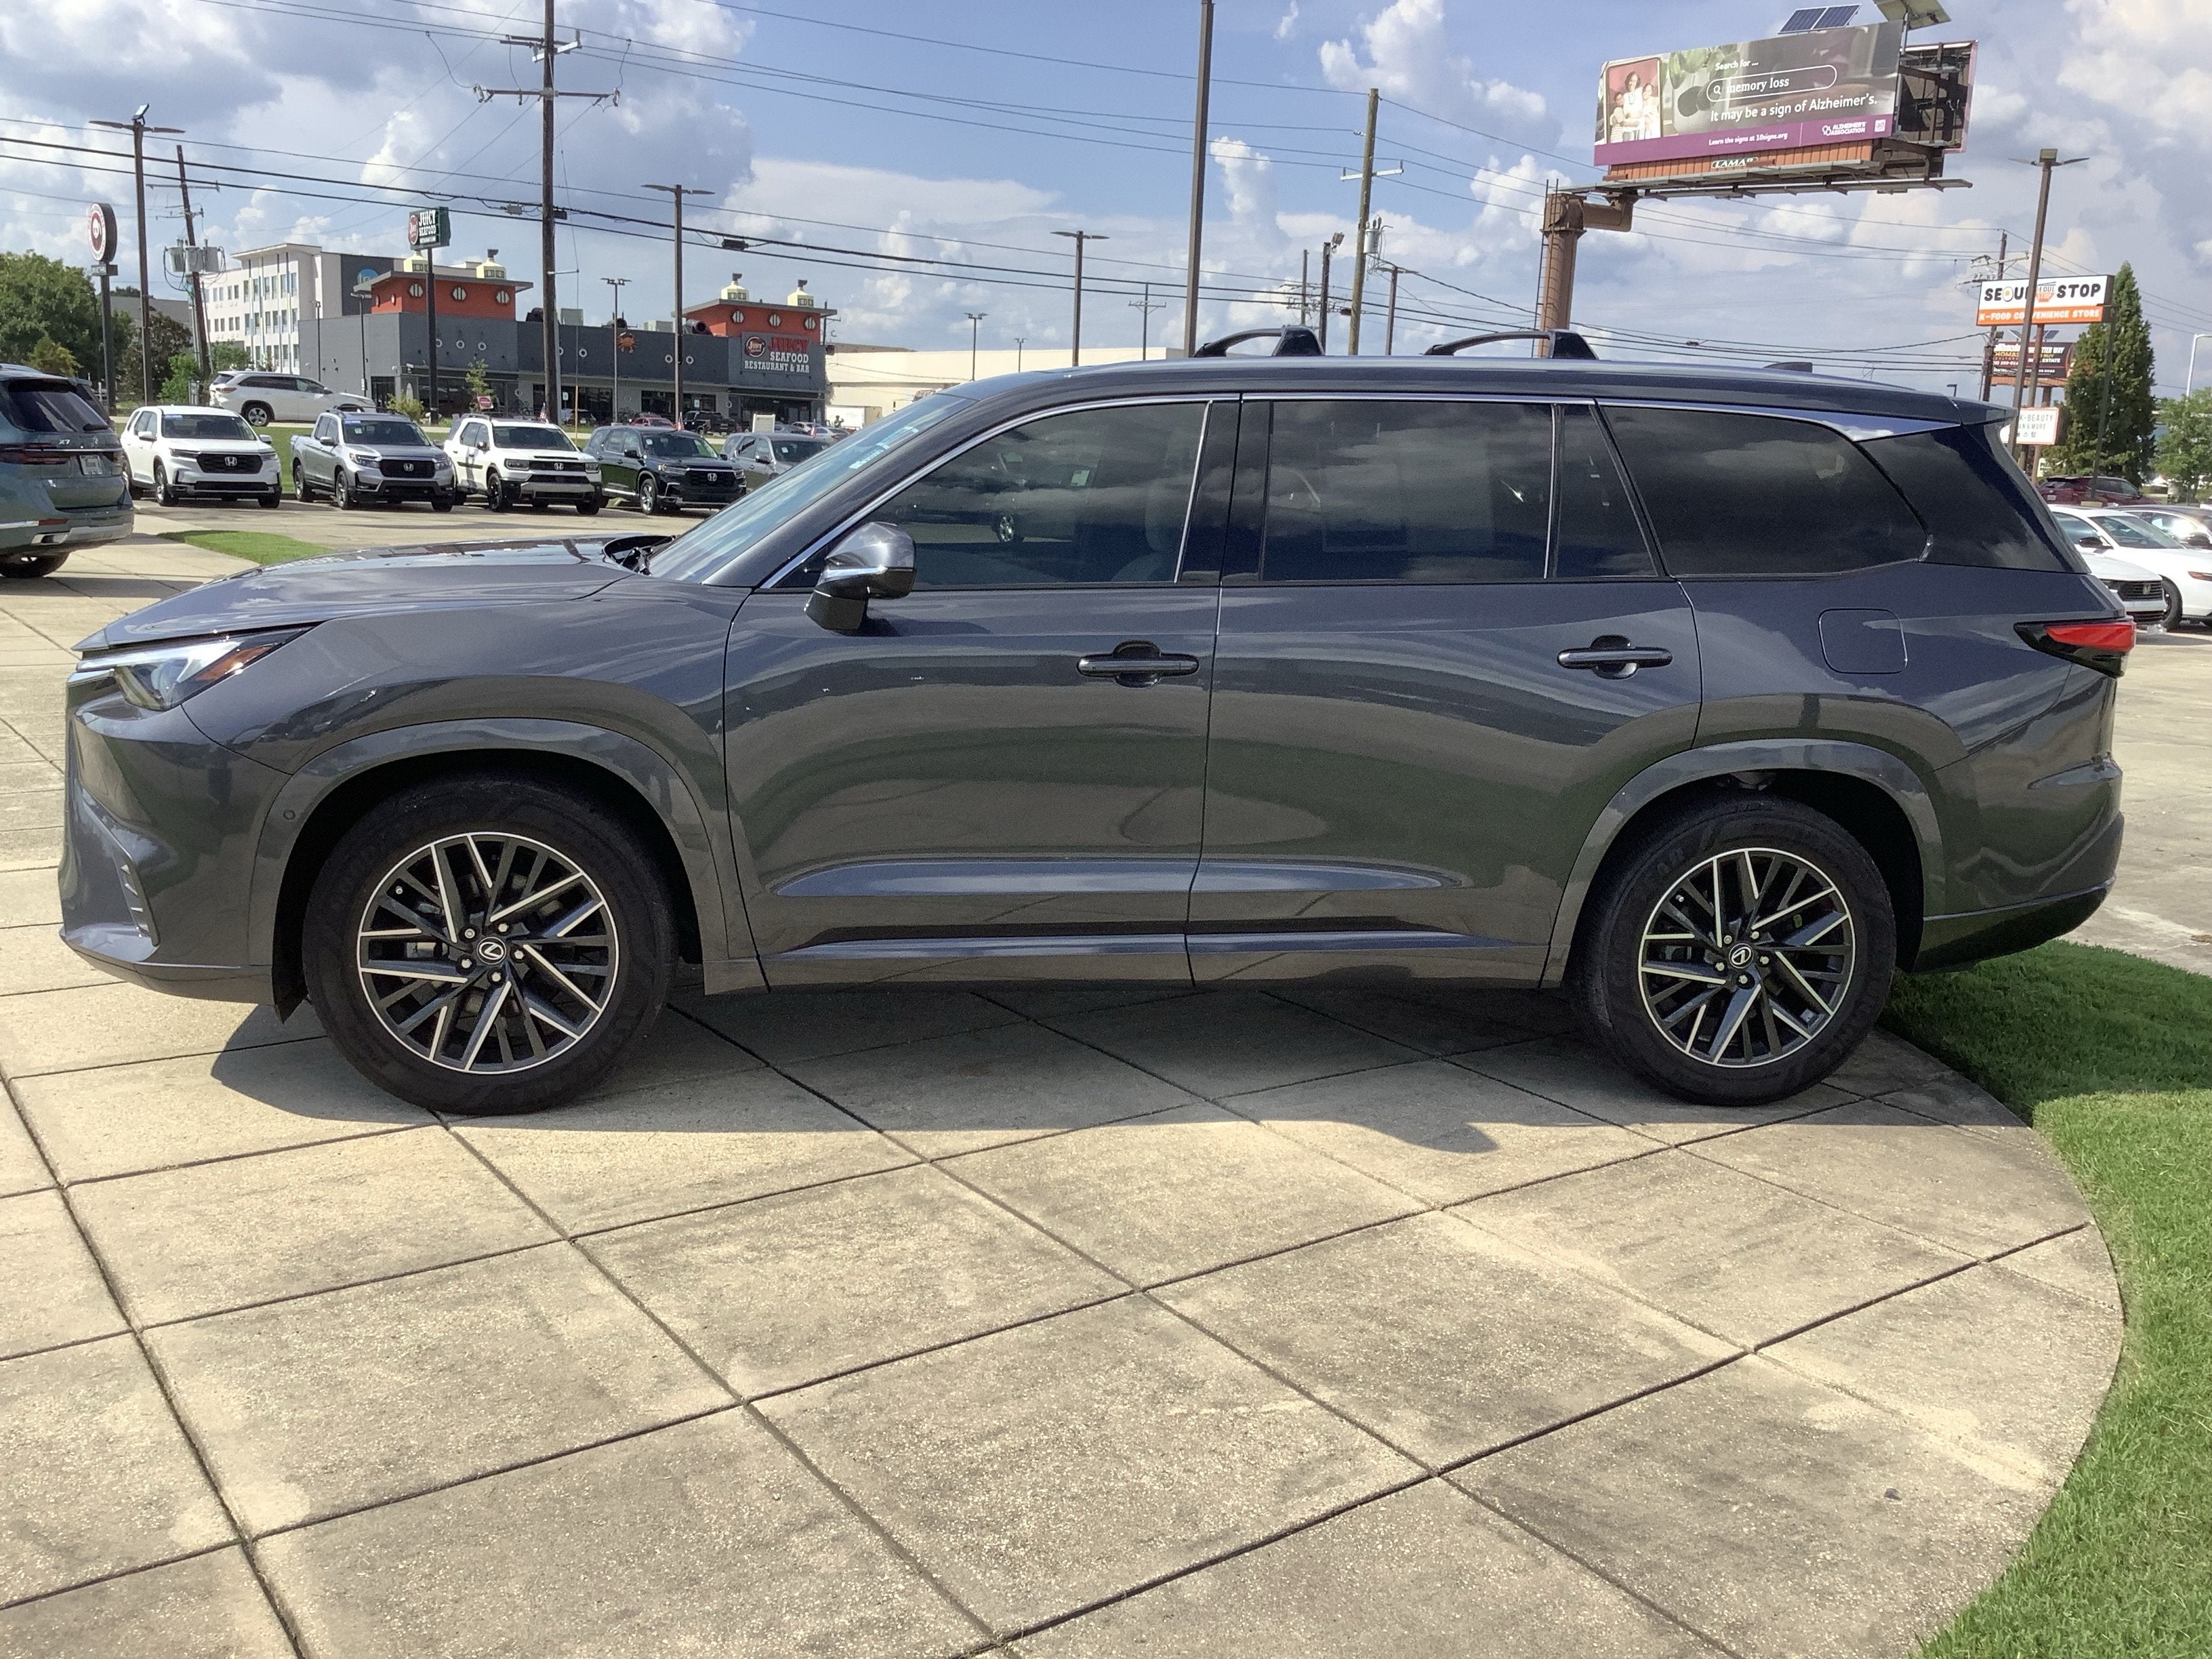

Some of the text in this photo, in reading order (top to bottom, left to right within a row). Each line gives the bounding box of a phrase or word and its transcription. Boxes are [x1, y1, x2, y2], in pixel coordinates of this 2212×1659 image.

[1715, 60, 1738, 70] Search
[1740, 60, 1751, 68] for
[1726, 77, 1790, 94] memory loss
[1711, 110, 1718, 122] It
[1721, 110, 1743, 122] may
[1745, 106, 1757, 118] be
[1761, 108, 1767, 117] a
[1769, 103, 1791, 118] sign
[1795, 100, 1807, 112] of
[1830, 127, 1866, 136] ASSOCIATION
[1735, 136, 1748, 144] signs
[418, 209, 436, 226] JUICY
[2057, 283, 2101, 299] STOP
[1979, 309, 2100, 321] K-FOOD COVENIENCE STORE
[768, 337, 809, 353] JUICY
[770, 351, 809, 363] SEAFOOD
[744, 360, 810, 373] RESTAURANT & BAR
